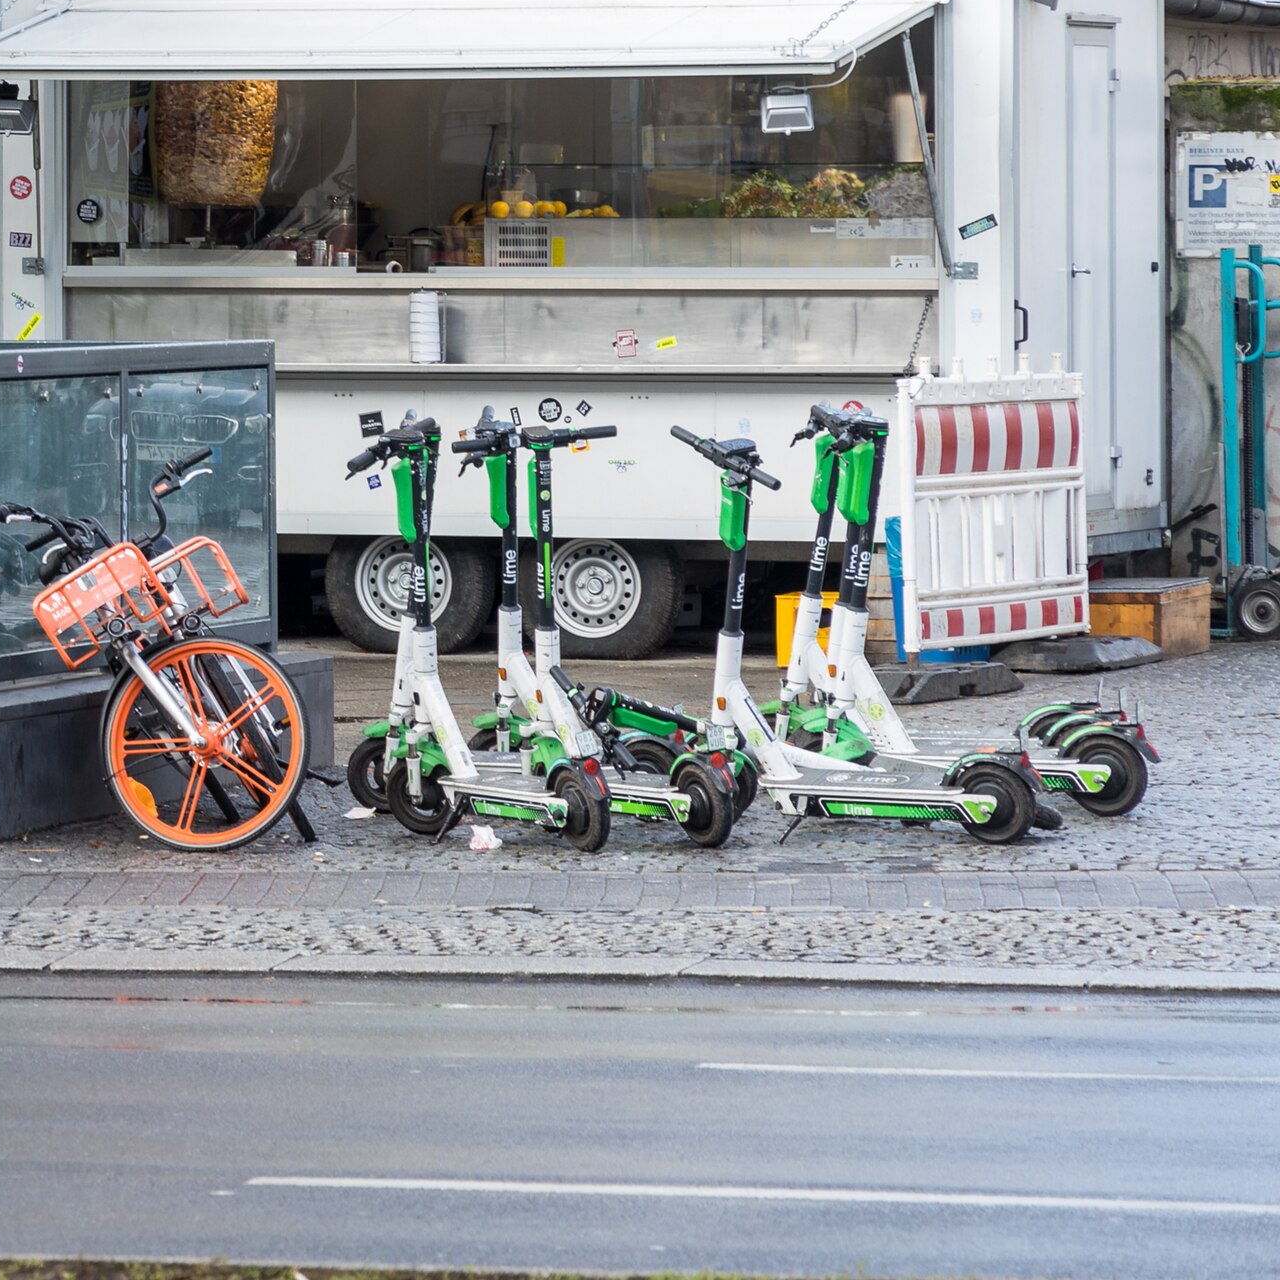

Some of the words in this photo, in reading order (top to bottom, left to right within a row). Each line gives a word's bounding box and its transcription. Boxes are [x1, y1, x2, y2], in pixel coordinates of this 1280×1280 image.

[1194, 167, 1222, 201] P
[10, 233, 31, 247] BZZ
[503, 549, 517, 584] Lime
[810, 536, 828, 572] Lime
[854, 551, 871, 587] Lime
[414, 565, 427, 603] Lime
[731, 572, 745, 609] Lime
[52, 599, 84, 621] Mobke
[843, 803, 873, 816] Lime
